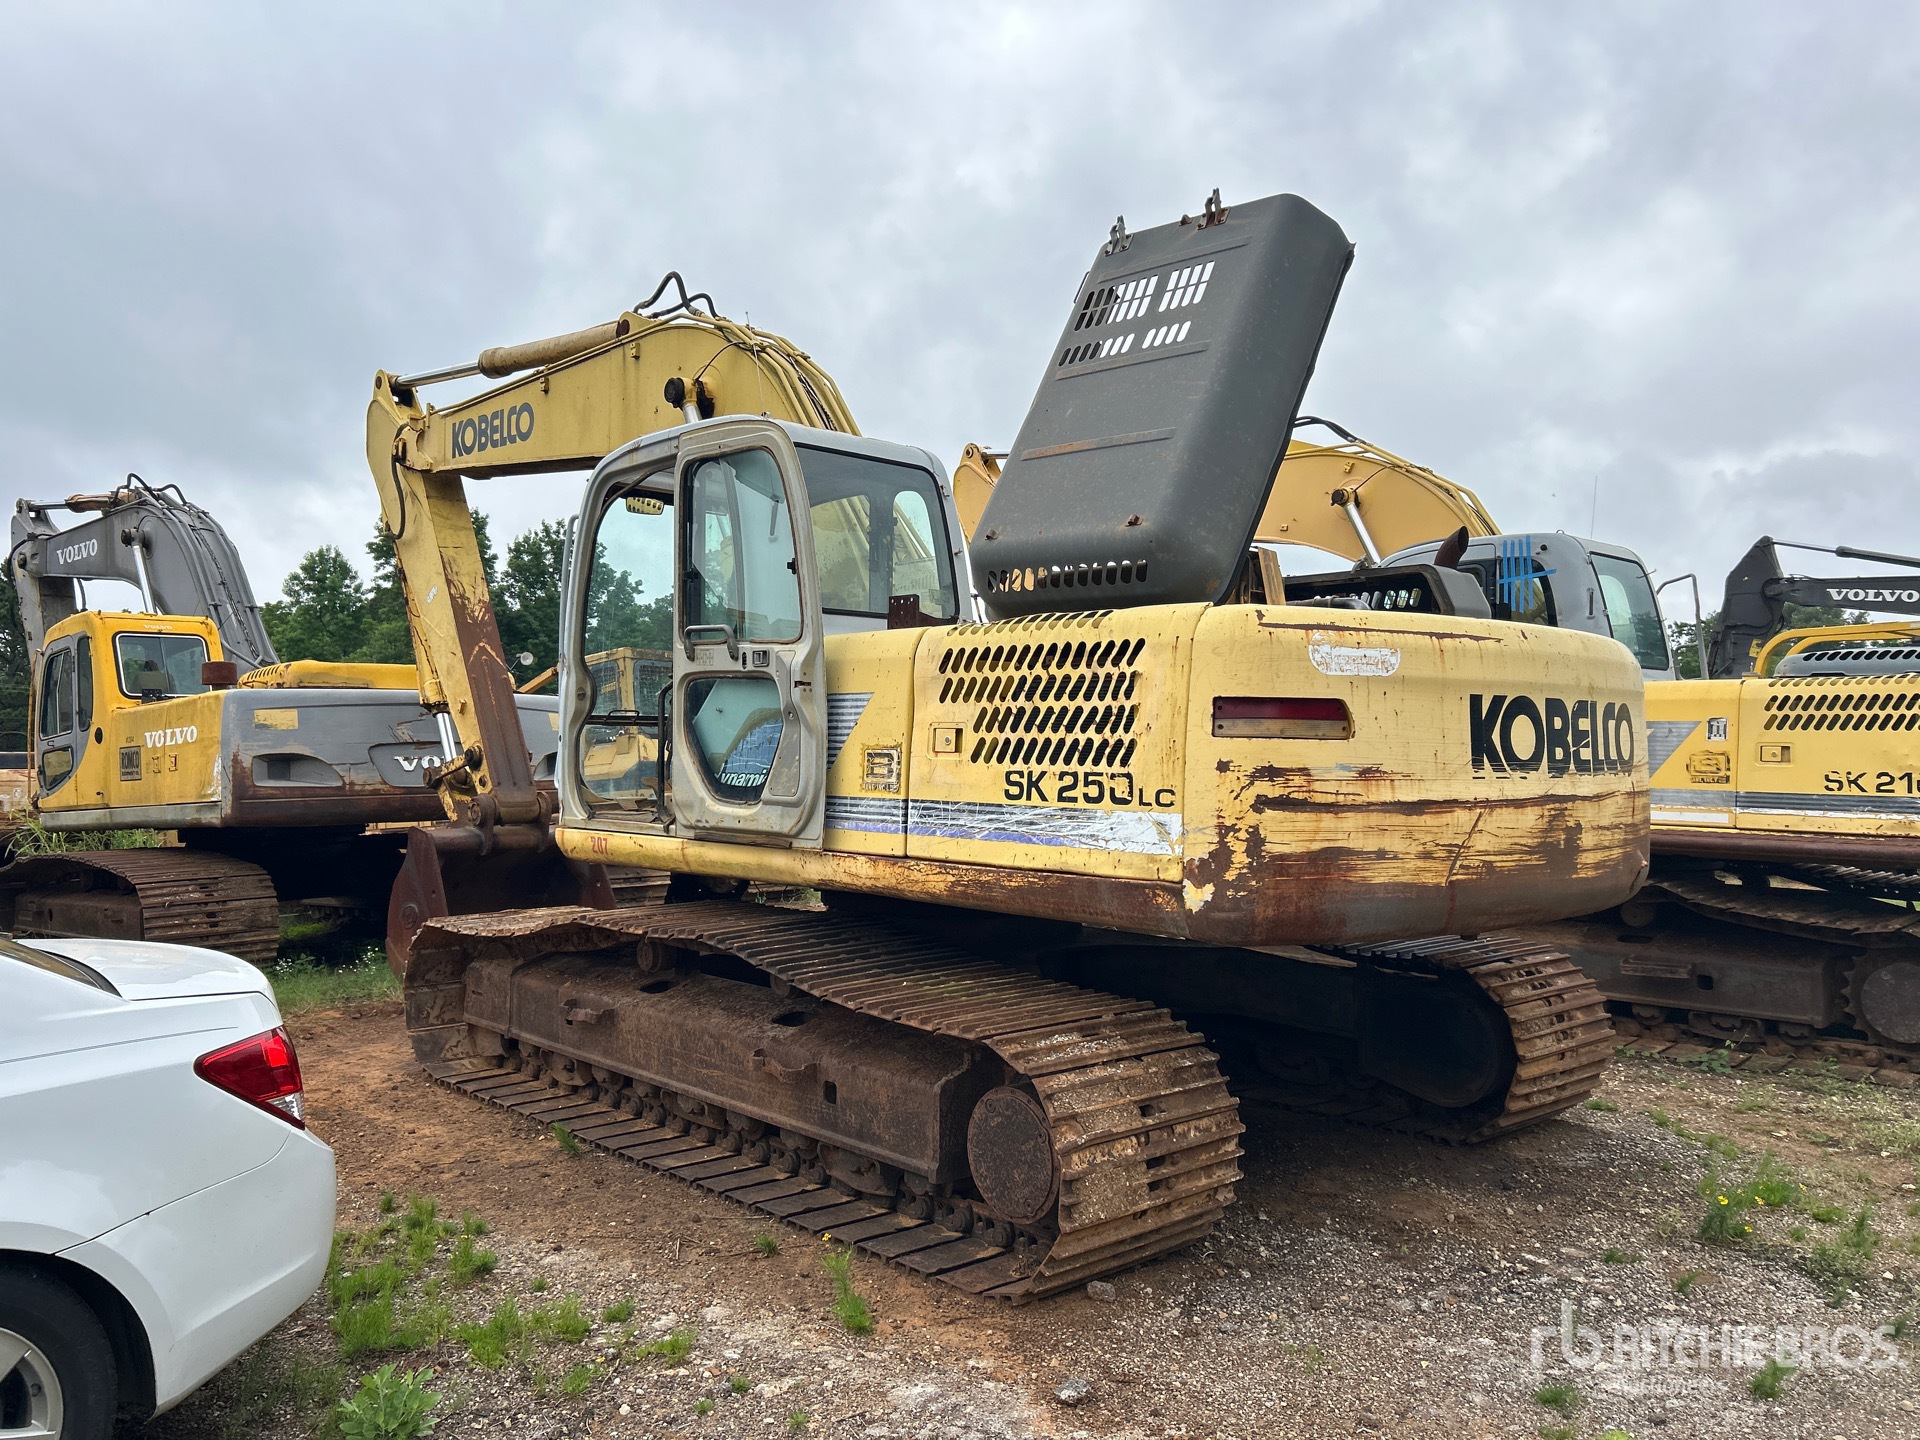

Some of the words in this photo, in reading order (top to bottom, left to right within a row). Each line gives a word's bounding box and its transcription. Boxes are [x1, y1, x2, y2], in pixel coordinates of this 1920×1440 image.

[452, 402, 534, 459] KOBELCO
[56, 539, 98, 565] VOLVO
[1826, 588, 1920, 603] VOLVO
[144, 725, 197, 749] VOLVO
[1469, 694, 1634, 779] KOBELCO
[1004, 770, 1049, 802] SK
[1824, 770, 1868, 793] SK
[1876, 771, 1920, 794] 21
